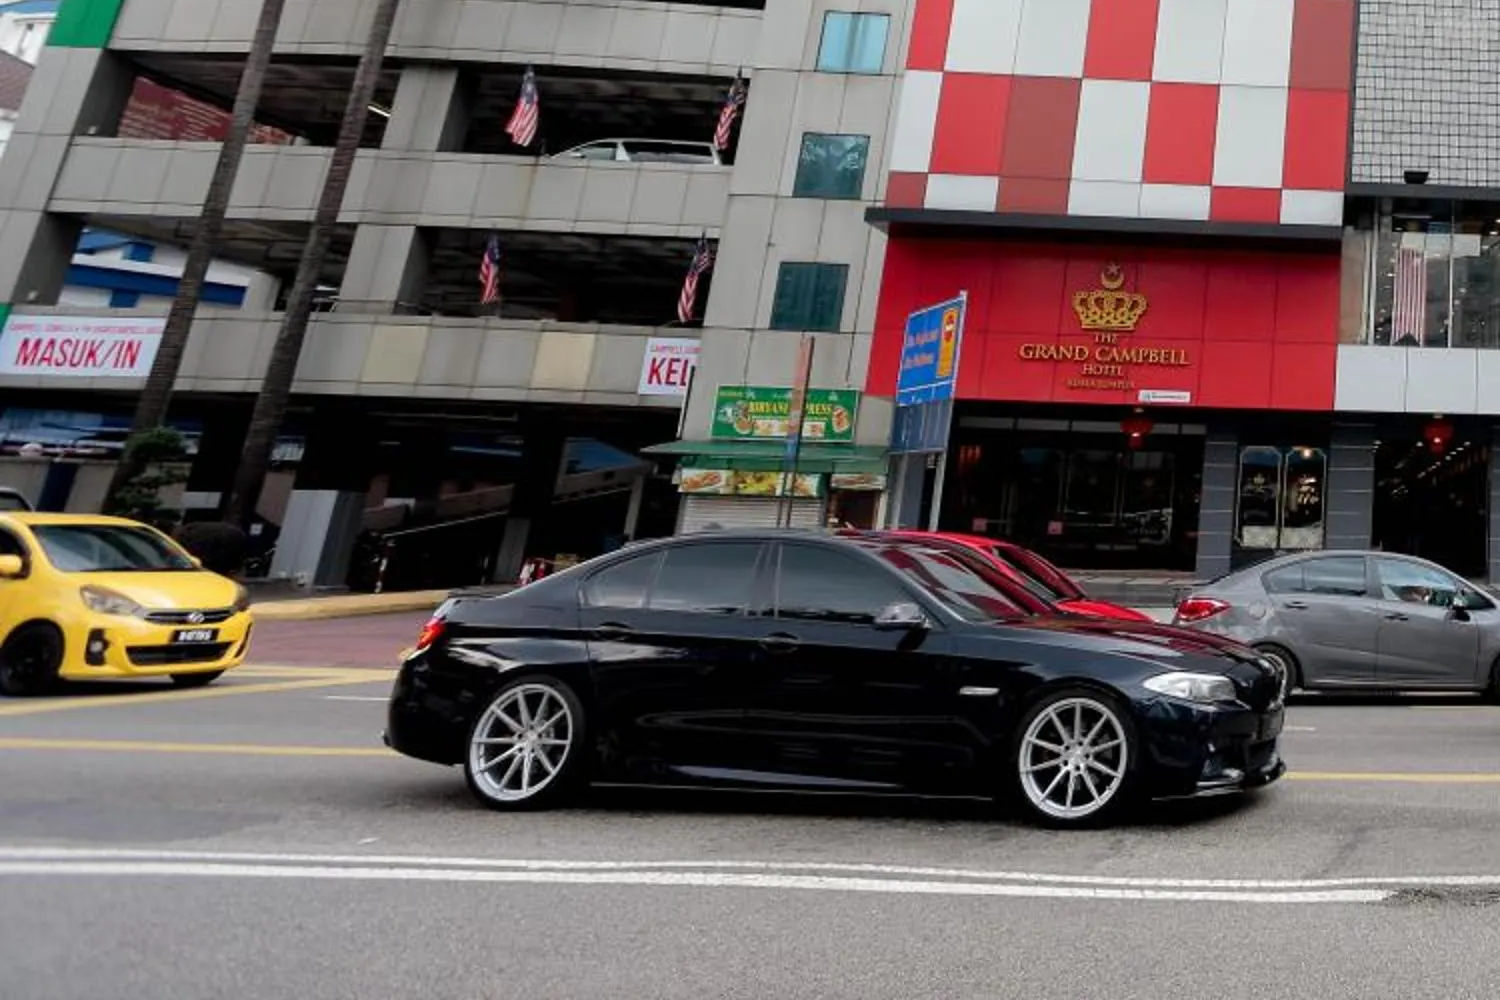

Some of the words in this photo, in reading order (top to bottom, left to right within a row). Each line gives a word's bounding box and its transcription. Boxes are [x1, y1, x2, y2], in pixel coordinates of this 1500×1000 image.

[1093, 333, 1118, 345] THE
[15, 337, 142, 369] MASUK/IN
[1019, 344, 1089, 361] GRAND
[1095, 346, 1191, 365] CAMPBELL
[1081, 364, 1124, 377] HOTEL
